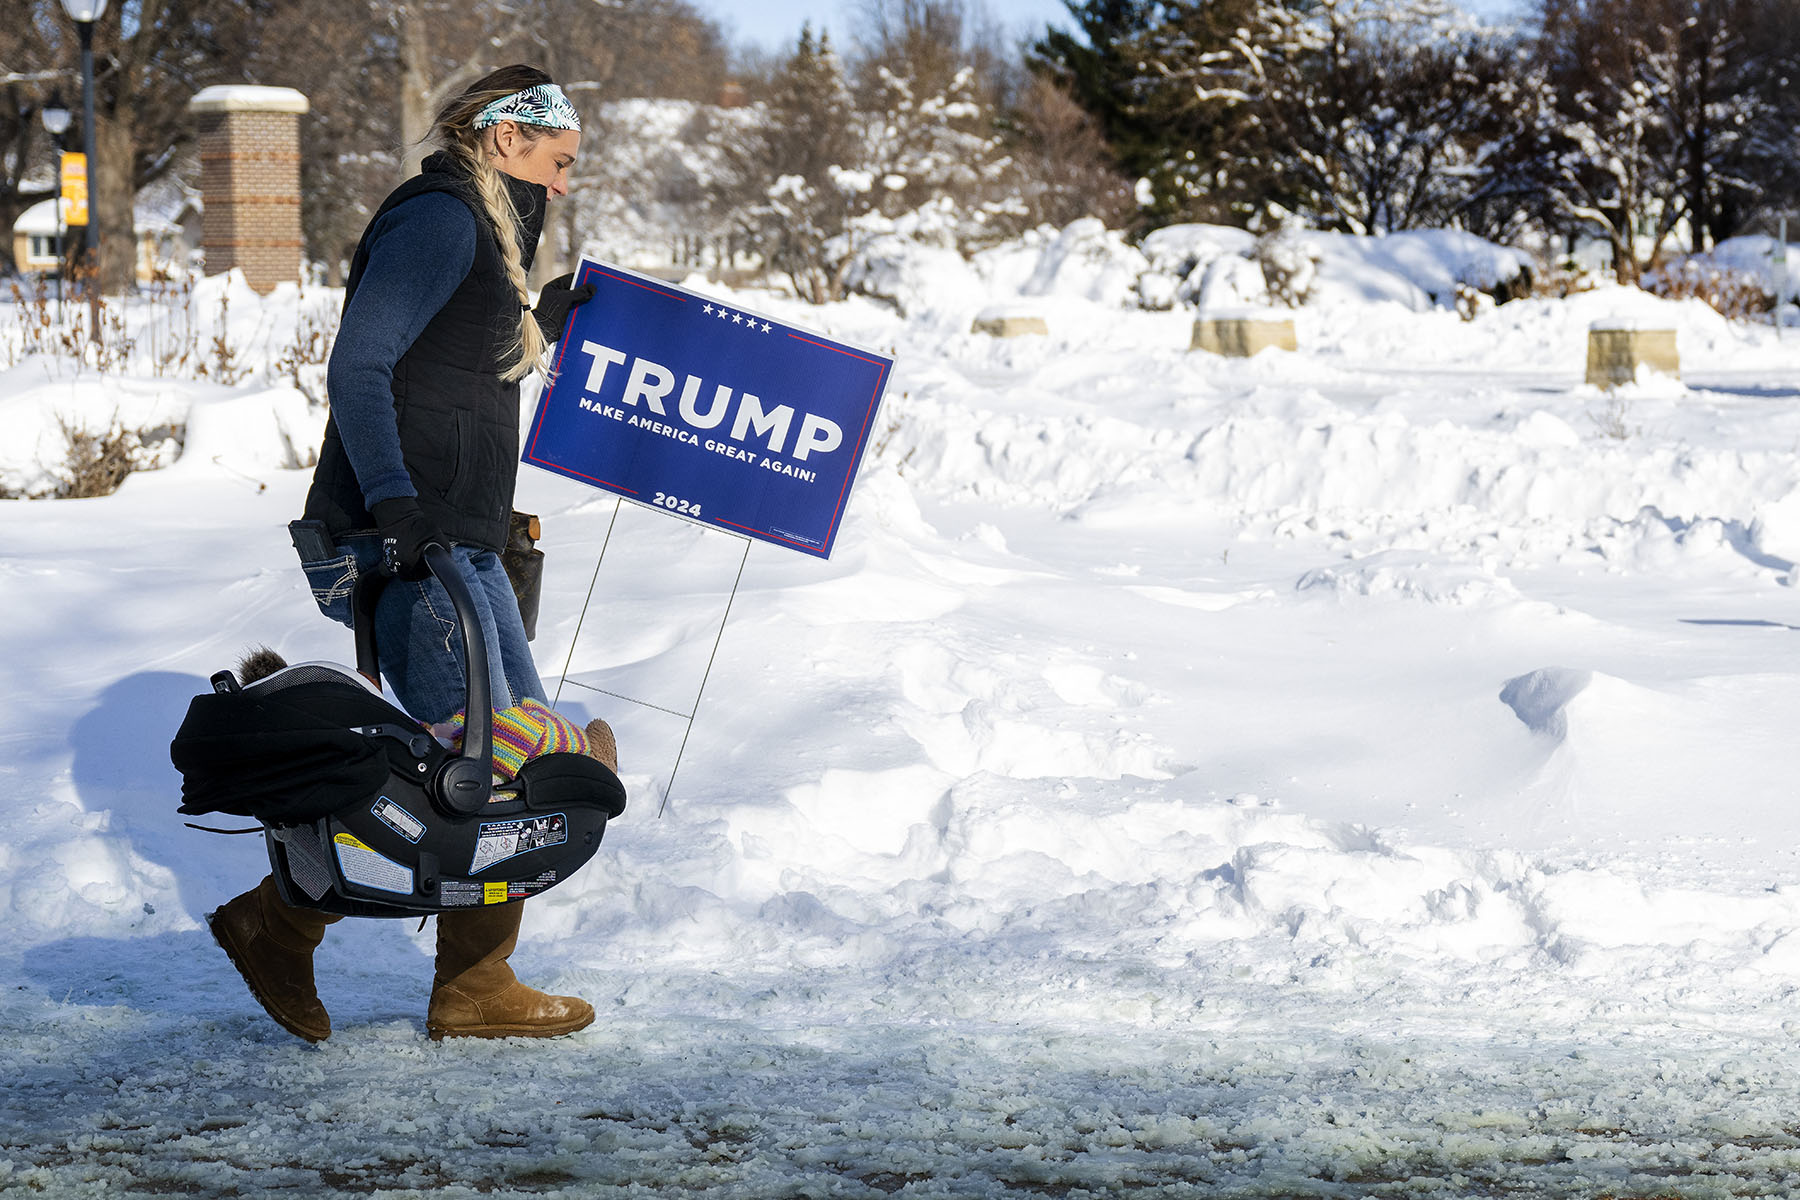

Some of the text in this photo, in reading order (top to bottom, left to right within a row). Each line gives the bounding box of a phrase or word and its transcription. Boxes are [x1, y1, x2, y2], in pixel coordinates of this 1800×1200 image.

[580, 397, 816, 482] MAKE AMERICA GREAT AGAIN!
[581, 340, 843, 461] TRUMP
[653, 492, 701, 517] 2024
